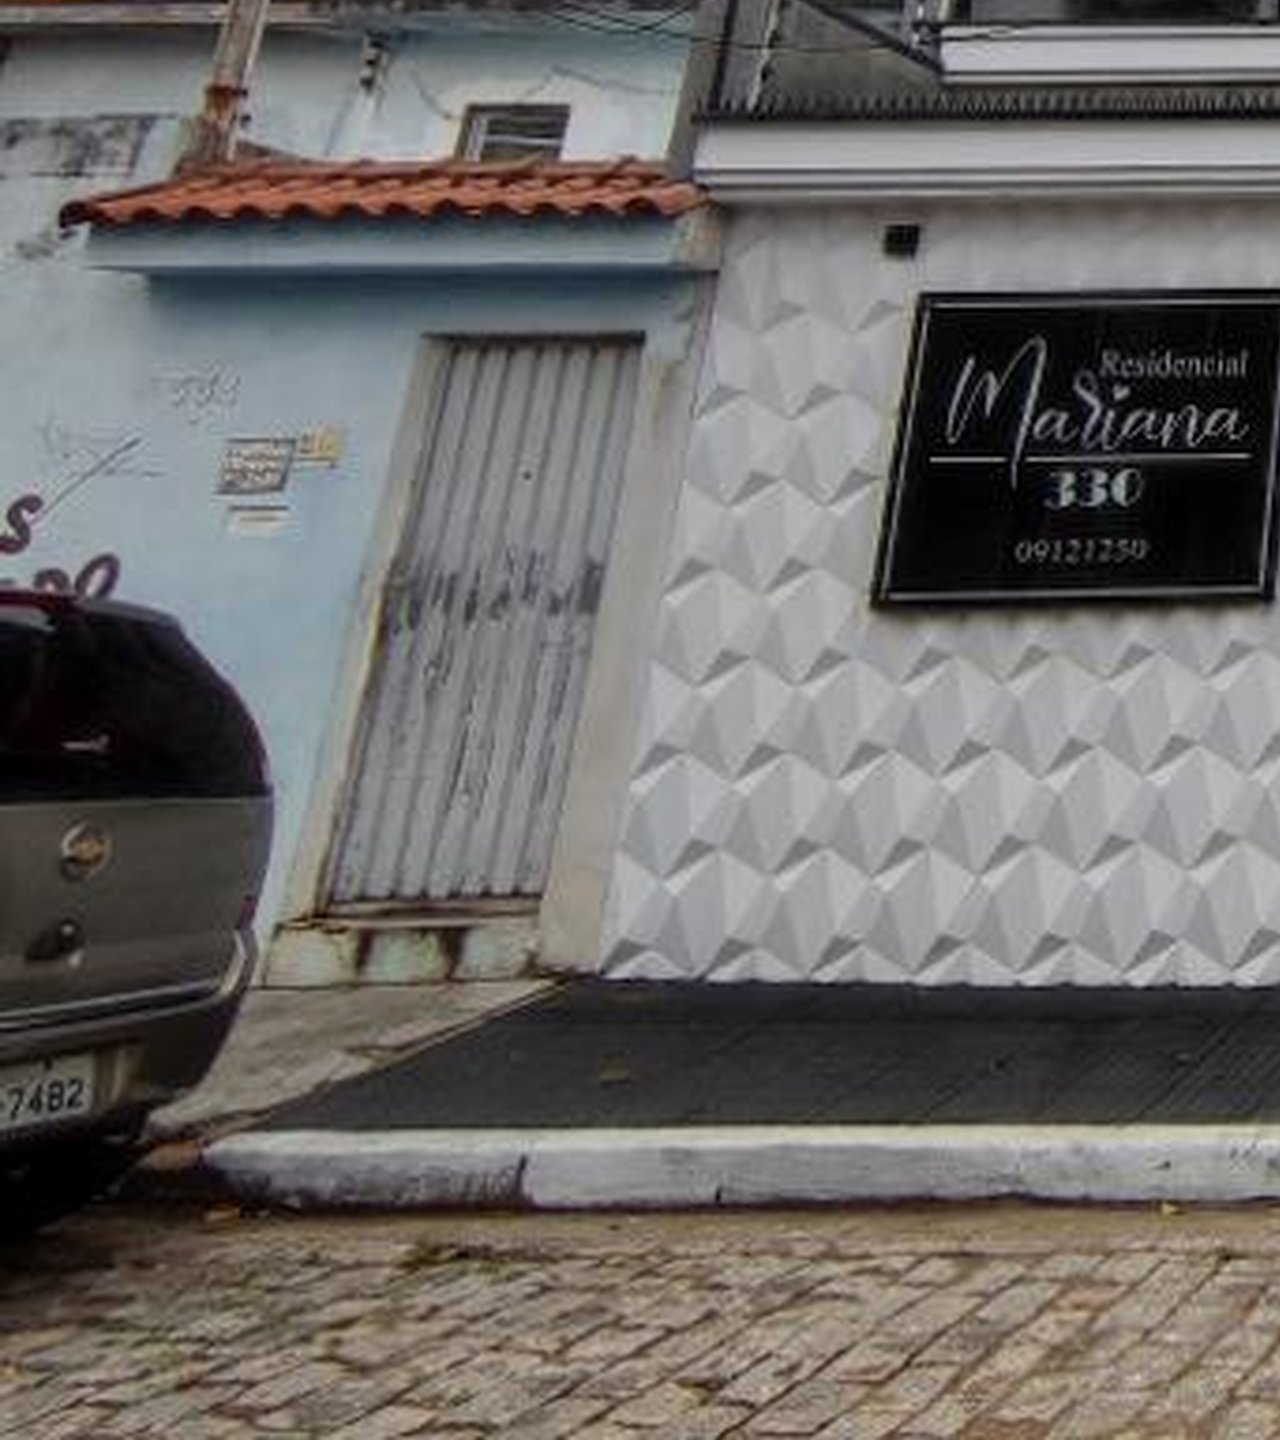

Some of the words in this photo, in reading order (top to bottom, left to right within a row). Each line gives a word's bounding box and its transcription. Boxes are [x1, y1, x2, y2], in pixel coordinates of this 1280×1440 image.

[1099, 349, 1249, 378] Residencial
[946, 334, 1251, 489] Mariana
[1044, 467, 1144, 508] 330
